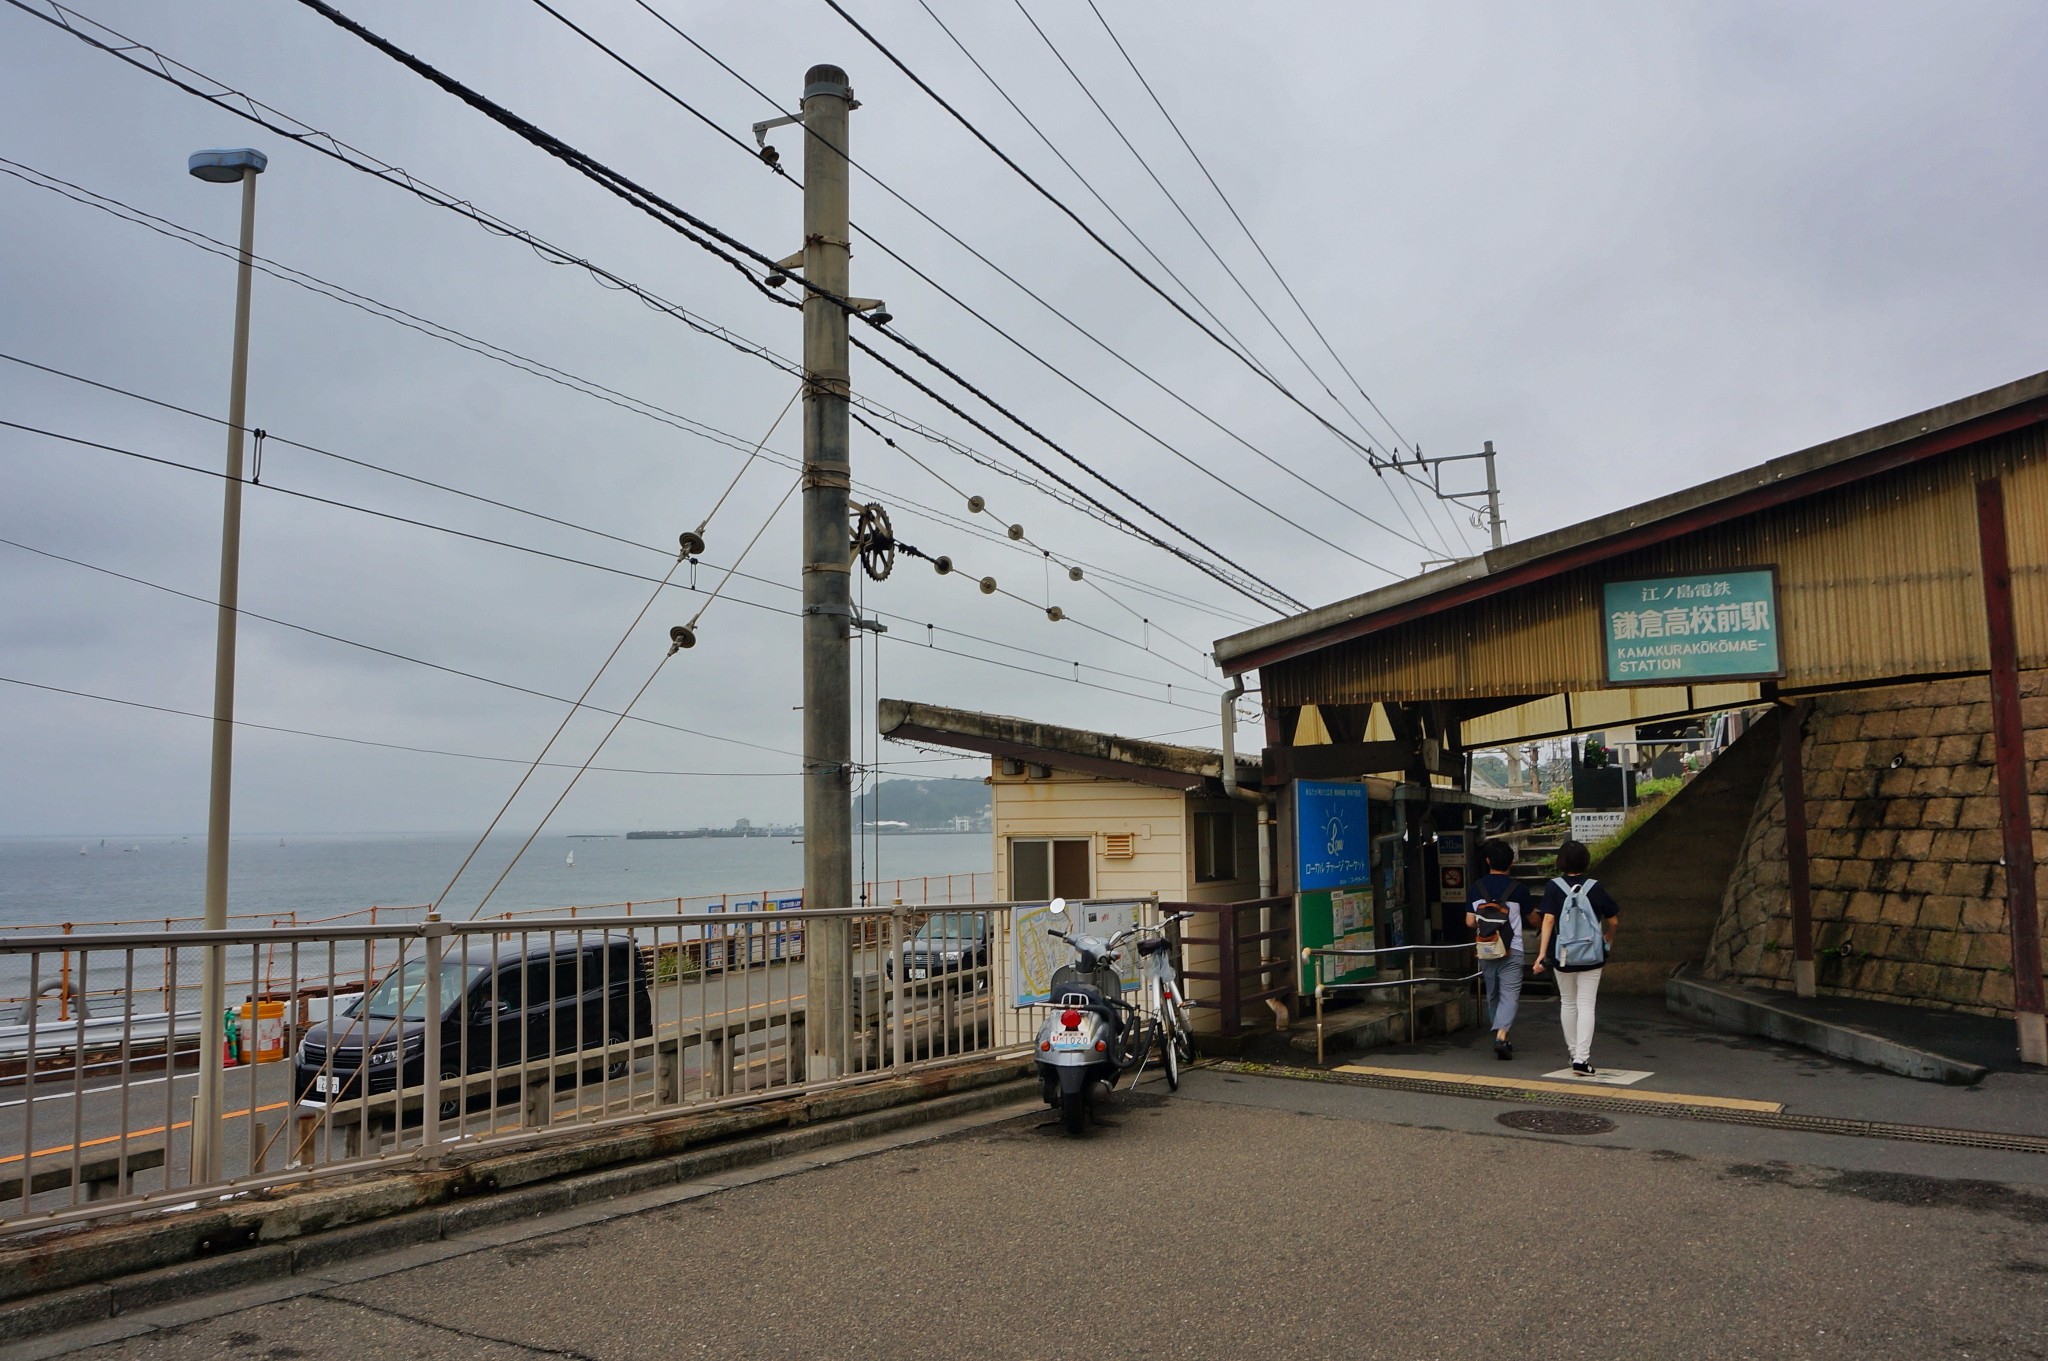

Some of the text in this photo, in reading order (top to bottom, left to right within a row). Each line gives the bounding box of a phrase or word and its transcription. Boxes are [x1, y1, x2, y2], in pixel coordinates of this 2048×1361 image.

[1641, 581, 1732, 602] 江ノ島電鉄
[1611, 600, 1771, 640] 鎌倉高校前駅
[1619, 658, 1681, 673] STATION
[1065, 1036, 1088, 1045] 1020
